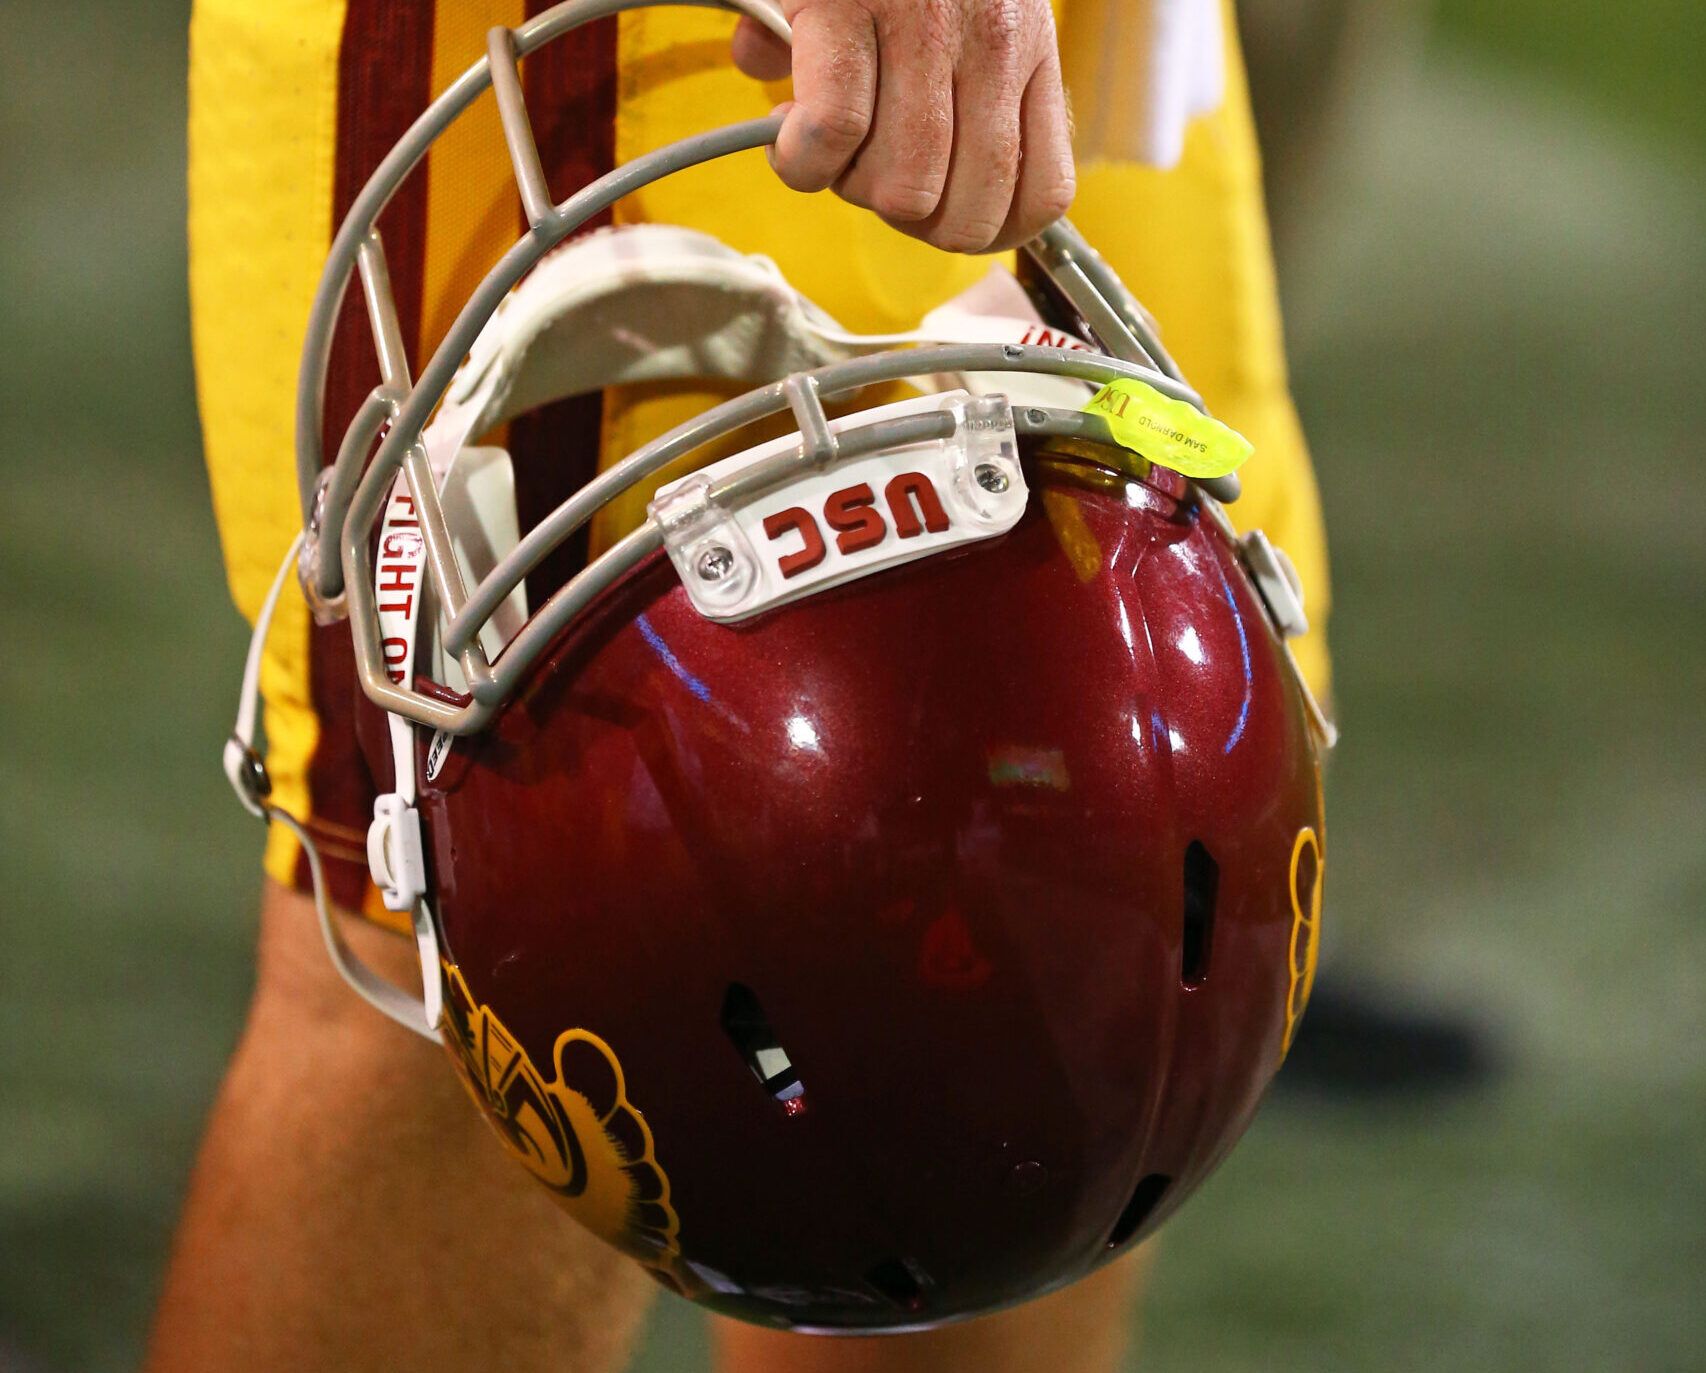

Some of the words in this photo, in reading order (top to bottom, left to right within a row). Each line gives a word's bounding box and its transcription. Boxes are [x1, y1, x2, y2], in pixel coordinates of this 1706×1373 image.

[1138, 416, 1184, 442] DARNOLD
[1184, 437, 1208, 453] SAM
[763, 472, 949, 578] USC
